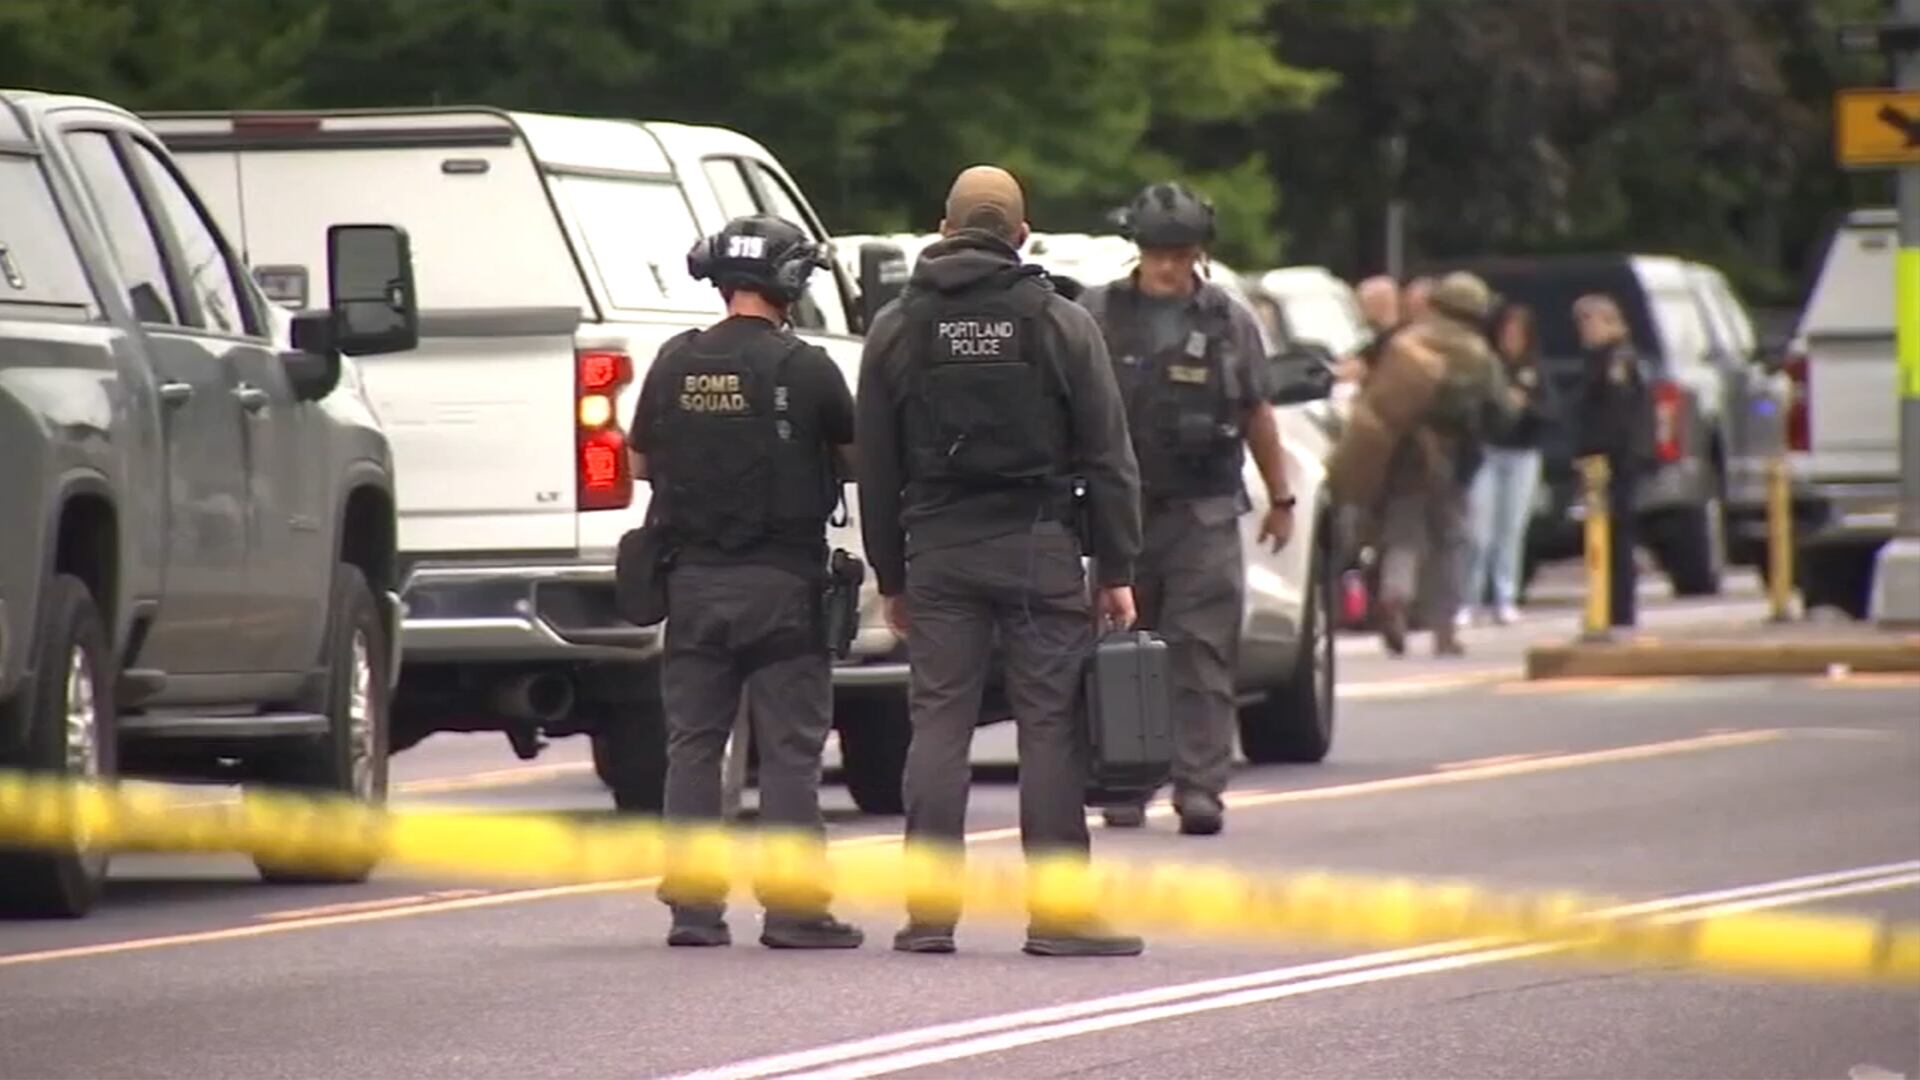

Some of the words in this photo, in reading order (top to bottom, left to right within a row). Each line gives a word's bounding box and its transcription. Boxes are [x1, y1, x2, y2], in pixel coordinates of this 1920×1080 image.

[939, 321, 1013, 338] PORTLAND
[951, 339, 1000, 355] POLICE
[685, 374, 739, 392] BOMB
[680, 394, 744, 411] SQUAD
